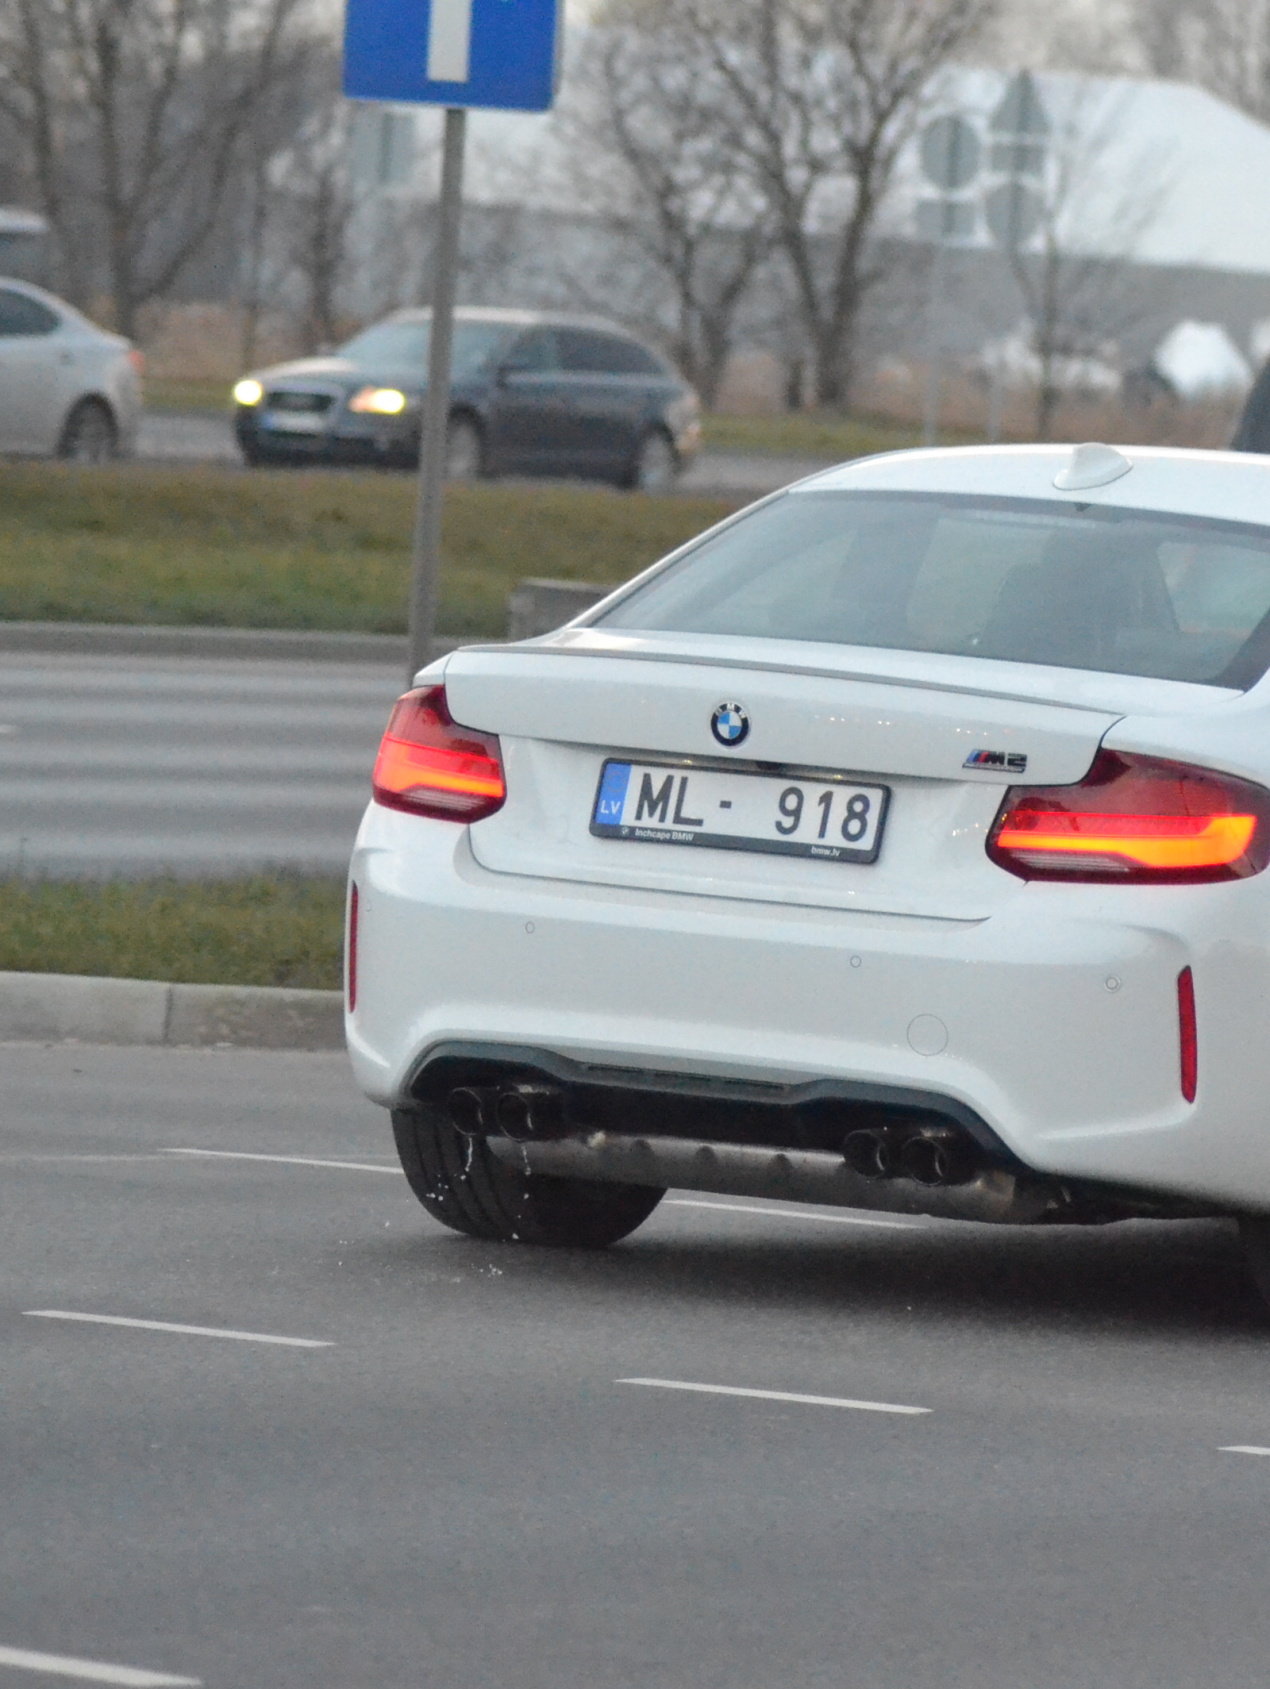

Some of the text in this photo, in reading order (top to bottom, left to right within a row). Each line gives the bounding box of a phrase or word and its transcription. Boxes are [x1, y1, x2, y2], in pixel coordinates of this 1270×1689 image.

[966, 749, 1027, 767] M2
[601, 800, 621, 814] LV
[775, 787, 870, 842] 918
[635, 828, 694, 841] Inchcape BMW
[811, 845, 840, 857] bmw.lv
